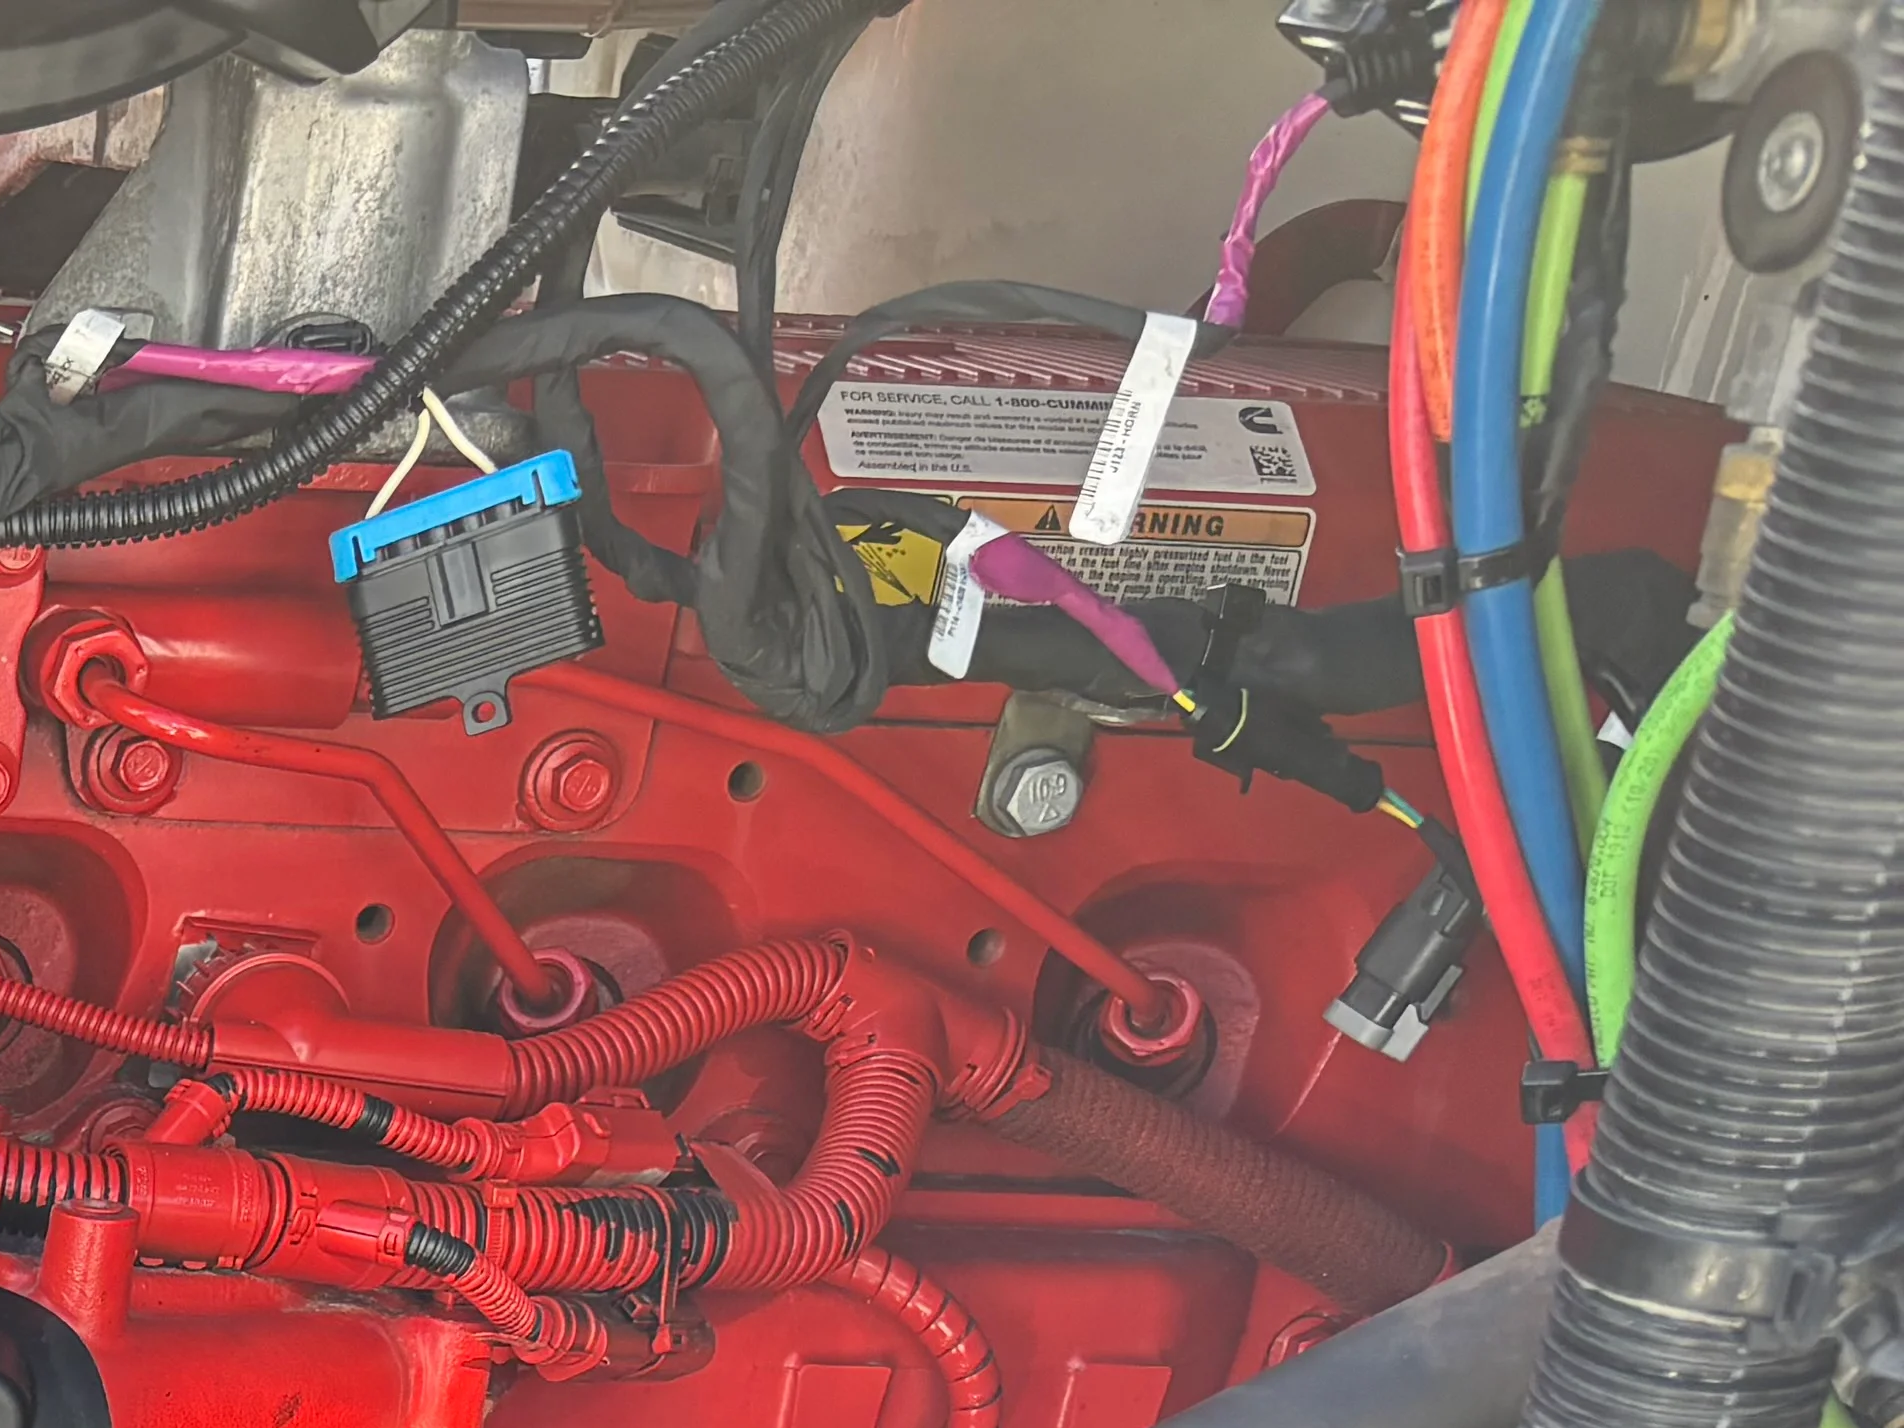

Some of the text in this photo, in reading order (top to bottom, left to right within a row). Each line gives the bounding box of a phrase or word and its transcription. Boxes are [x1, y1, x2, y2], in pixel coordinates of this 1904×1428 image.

[840, 391, 873, 402] FOR
[877, 392, 947, 405] SERVICE,
[950, 394, 991, 407] CALL
[1132, 512, 1224, 536] RNING
